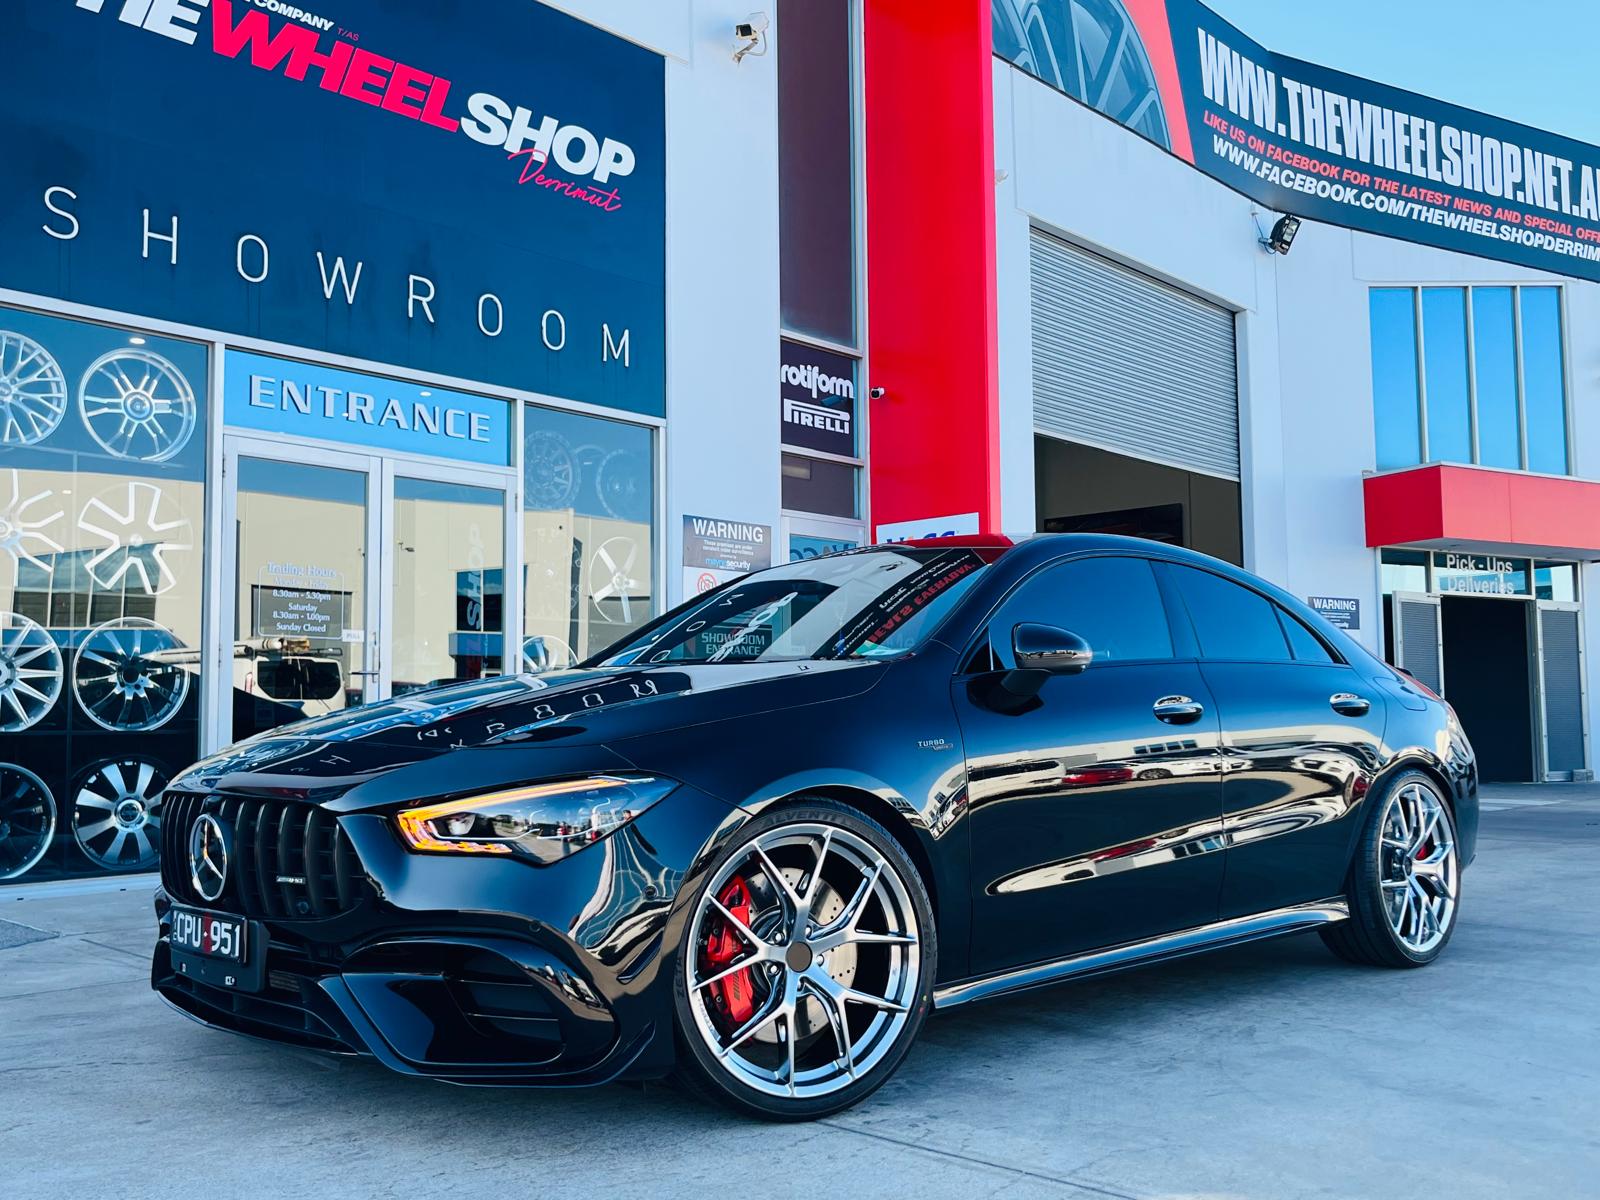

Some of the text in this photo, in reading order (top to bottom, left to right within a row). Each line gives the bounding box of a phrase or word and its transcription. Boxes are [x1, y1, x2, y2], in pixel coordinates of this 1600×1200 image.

[1197, 27, 1600, 222] WWW.THEWHEELSHOP.NET.A
[508, 148, 622, 211] Derrimut
[1203, 110, 1228, 134] LIKE
[1229, 125, 1246, 144] US
[1247, 135, 1265, 154] ON
[1266, 144, 1340, 179] FACEBOOK
[1342, 168, 1370, 187] FOR
[1374, 176, 1399, 194] THE
[1401, 184, 1451, 207] LATEST
[1453, 197, 1492, 217] NEWS
[1494, 207, 1521, 223] AND
[1524, 214, 1573, 236] SPECIAL
[42, 185, 631, 368] SHOWROOM
[781, 364, 854, 399] rotiform
[249, 374, 491, 443] ENTRANCE
[783, 398, 850, 434] PIRELLI
[692, 518, 763, 543] WARNING
[267, 562, 337, 578] Trading Hours
[1446, 554, 1476, 571] Pick
[1486, 557, 1514, 575] Ups
[272, 589, 299, 599] 8.30am
[305, 591, 331, 602] 5.30pm
[1448, 576, 1515, 595] Deliveries
[288, 602, 318, 612] Saturday
[1313, 598, 1356, 611] WARNING
[272, 611, 299, 620] 8.30am
[306, 612, 330, 622] 1.00pm
[276, 621, 326, 633] Sunday Closed
[917, 738, 945, 748] TURBO
[177, 911, 241, 957] CPU 951
